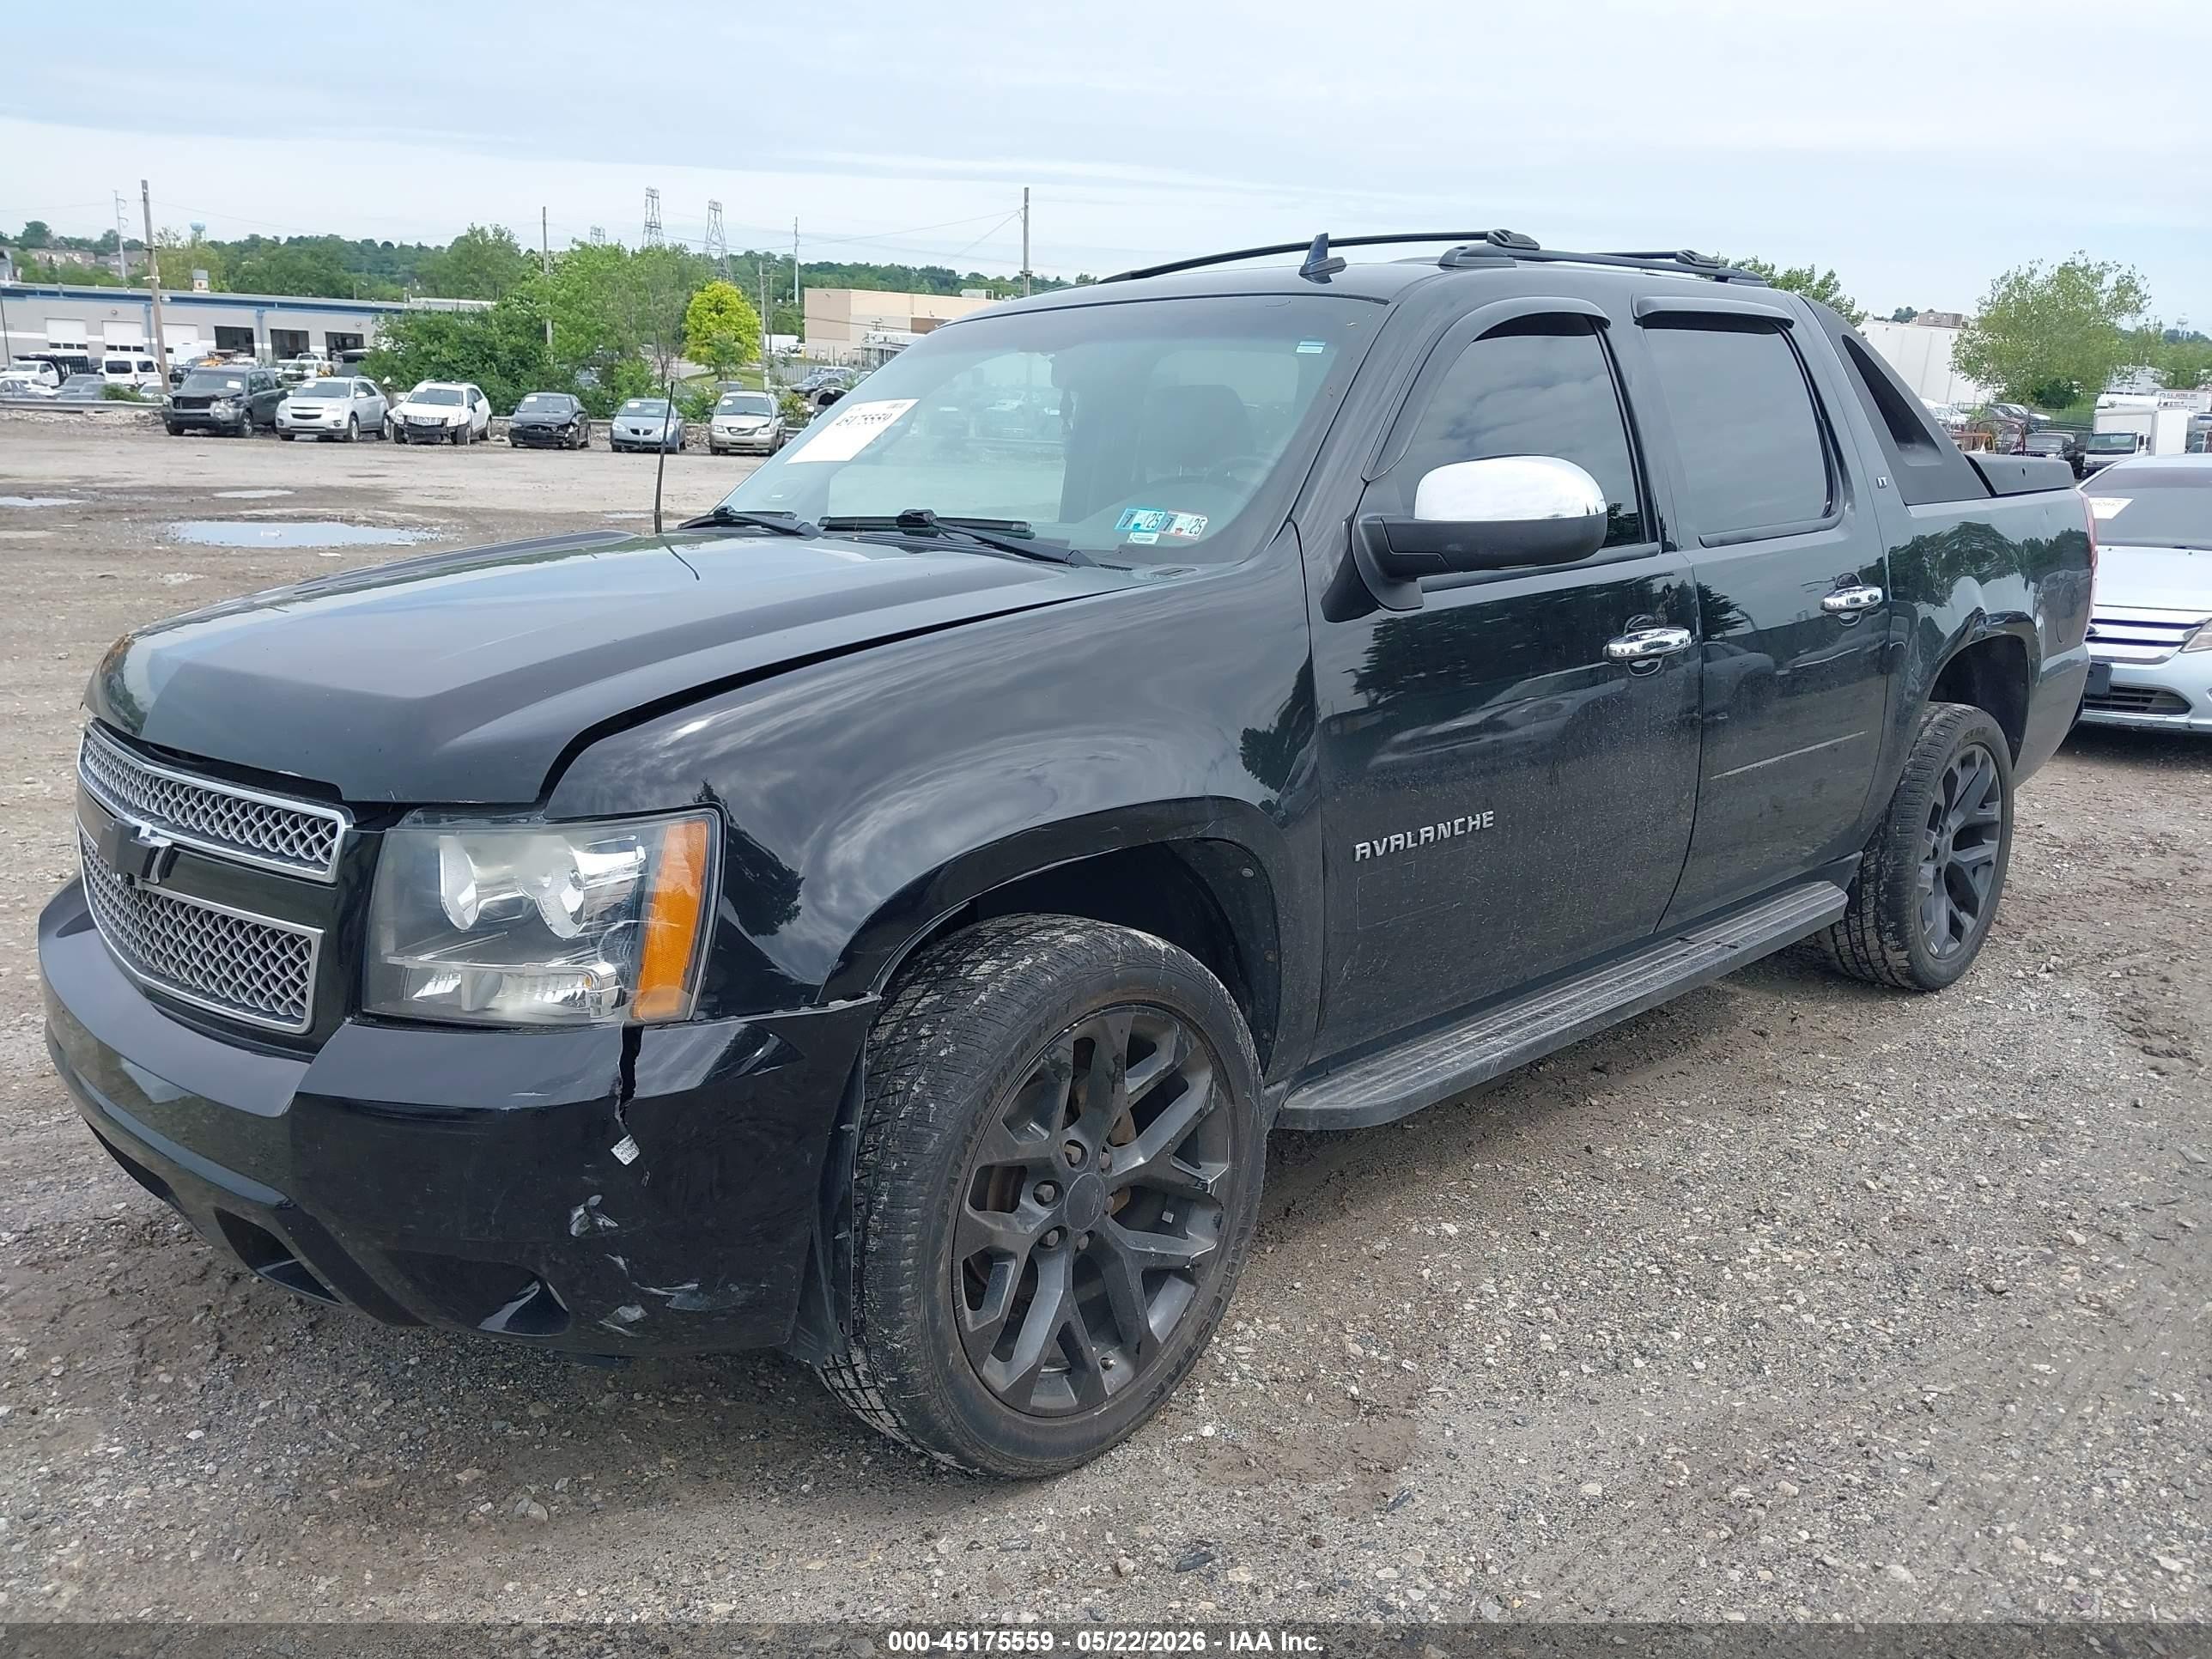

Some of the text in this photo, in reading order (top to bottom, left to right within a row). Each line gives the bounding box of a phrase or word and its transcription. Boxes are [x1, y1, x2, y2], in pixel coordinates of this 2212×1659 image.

[1188, 518, 1206, 535] 25
[1354, 810, 1495, 862] AVALANCHE
[1140, 1226, 1251, 1409] MILESTAR
